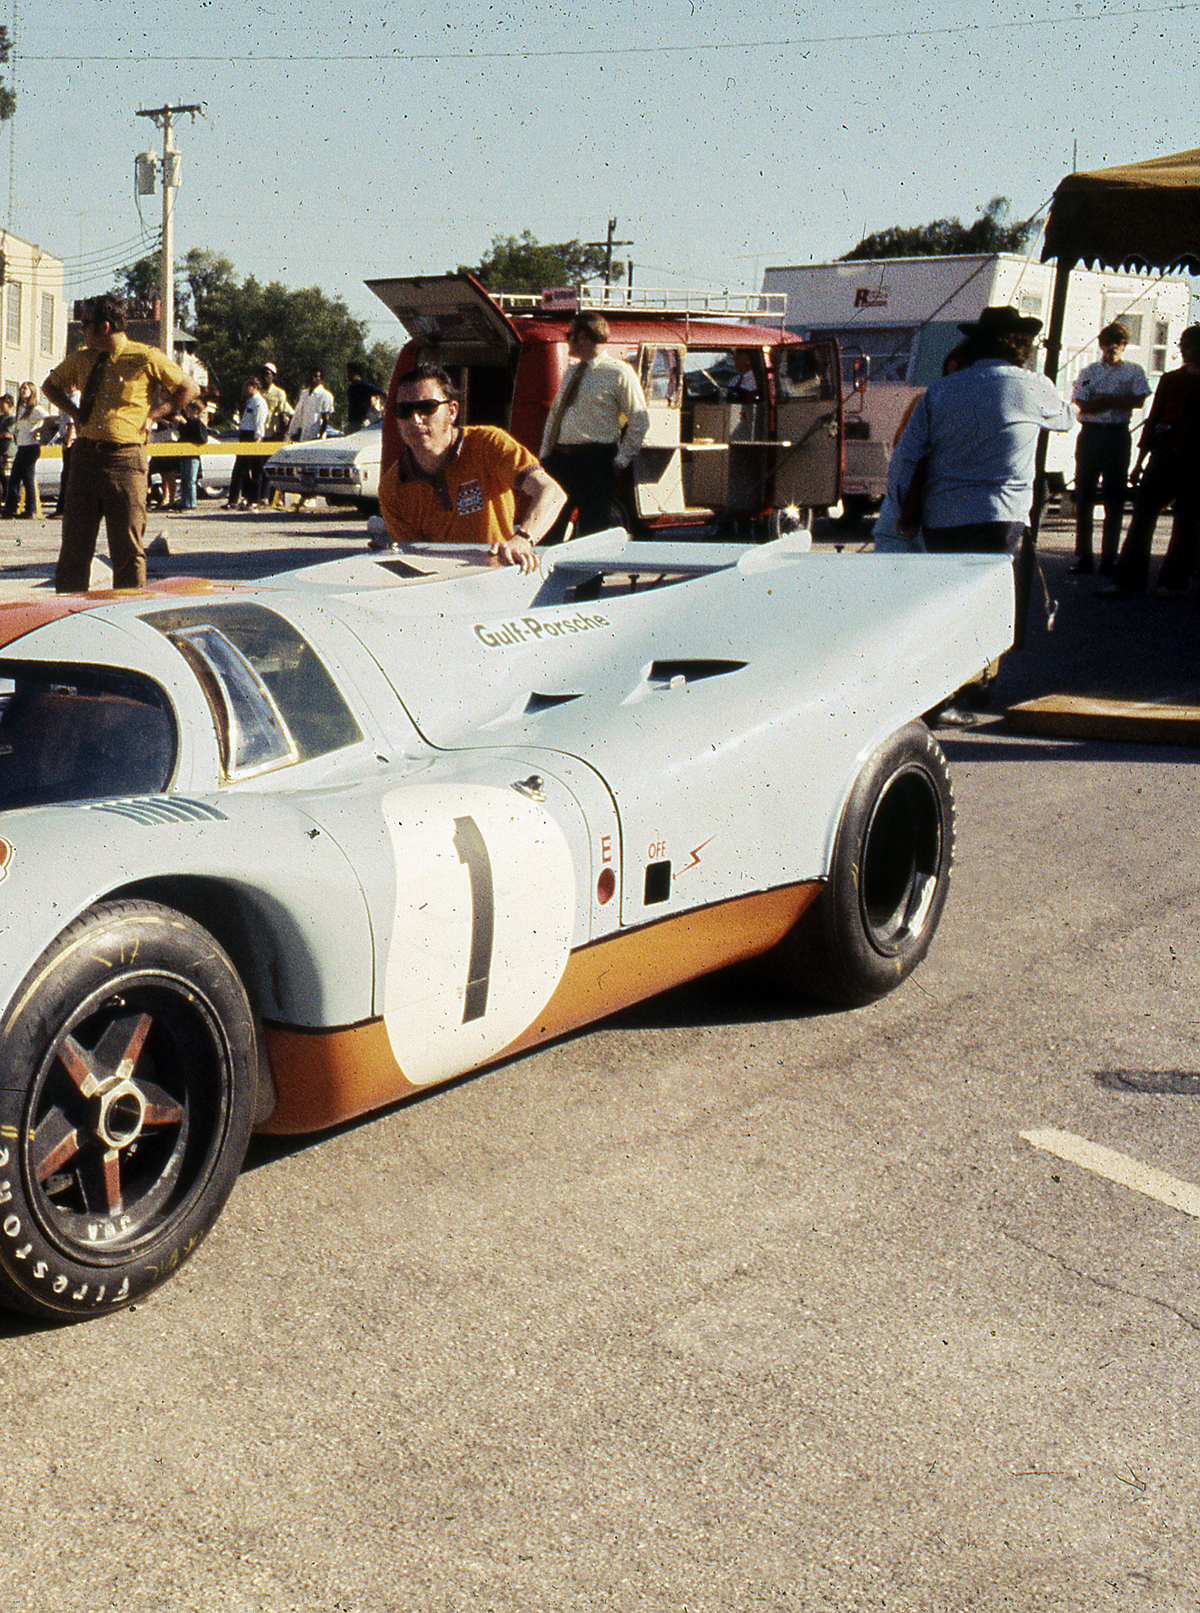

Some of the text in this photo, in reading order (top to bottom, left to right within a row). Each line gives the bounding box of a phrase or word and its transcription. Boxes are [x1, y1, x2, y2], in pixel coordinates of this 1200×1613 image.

[474, 612, 611, 648] Gulf-Porsche
[601, 835, 612, 864] E
[647, 841, 667, 859] OFF
[452, 815, 495, 1025] 1
